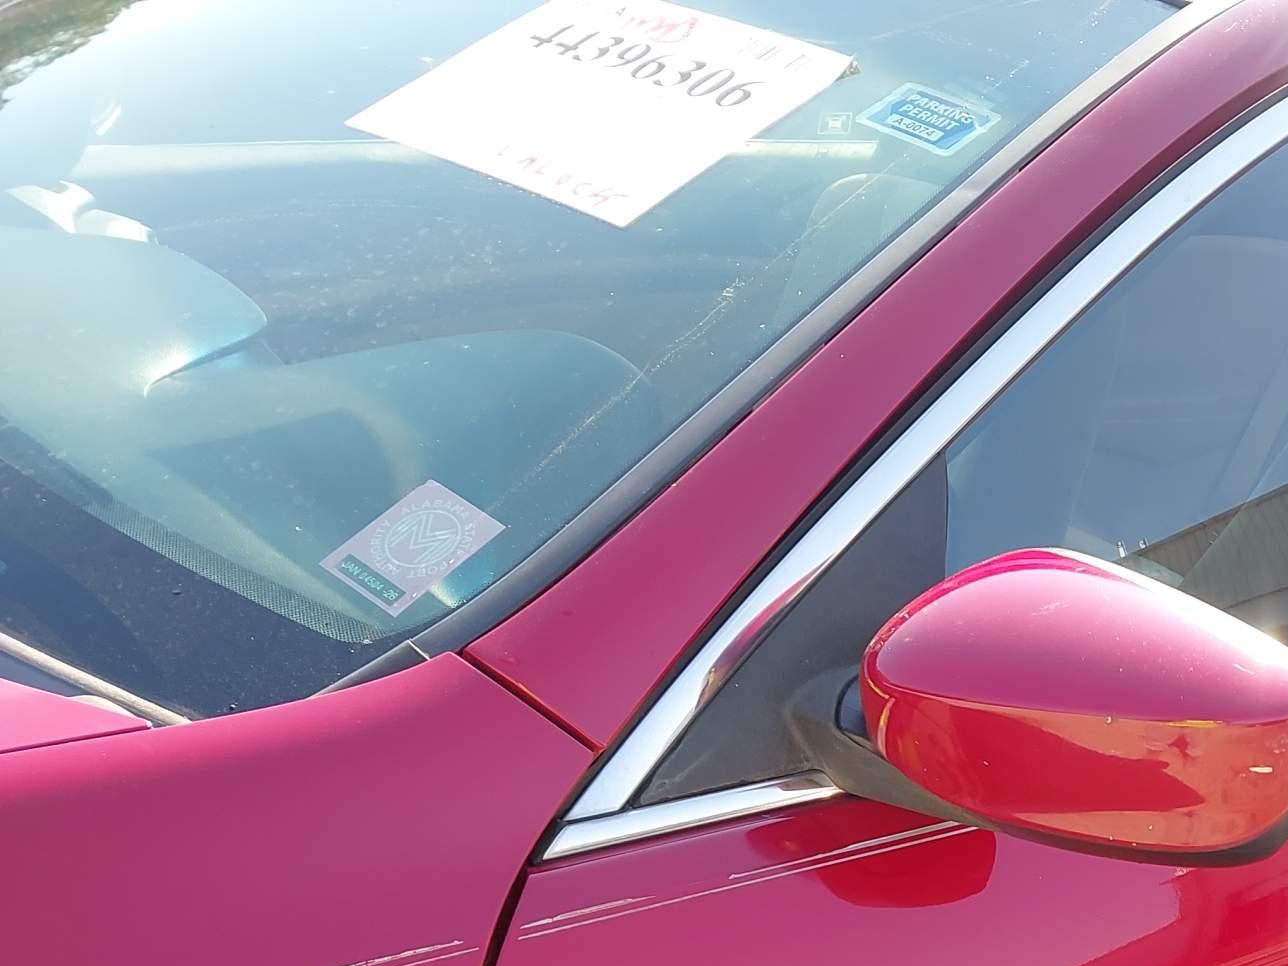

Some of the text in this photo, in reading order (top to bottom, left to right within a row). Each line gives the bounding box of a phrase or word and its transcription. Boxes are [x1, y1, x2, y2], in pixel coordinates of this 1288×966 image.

[530, 24, 768, 108] 44396306
[898, 104, 961, 131] PERMIT
[905, 93, 976, 124] PARKING
[370, 498, 478, 578] ALABAMA STATE PORT AUTHORITY
[340, 560, 362, 576] JAN
